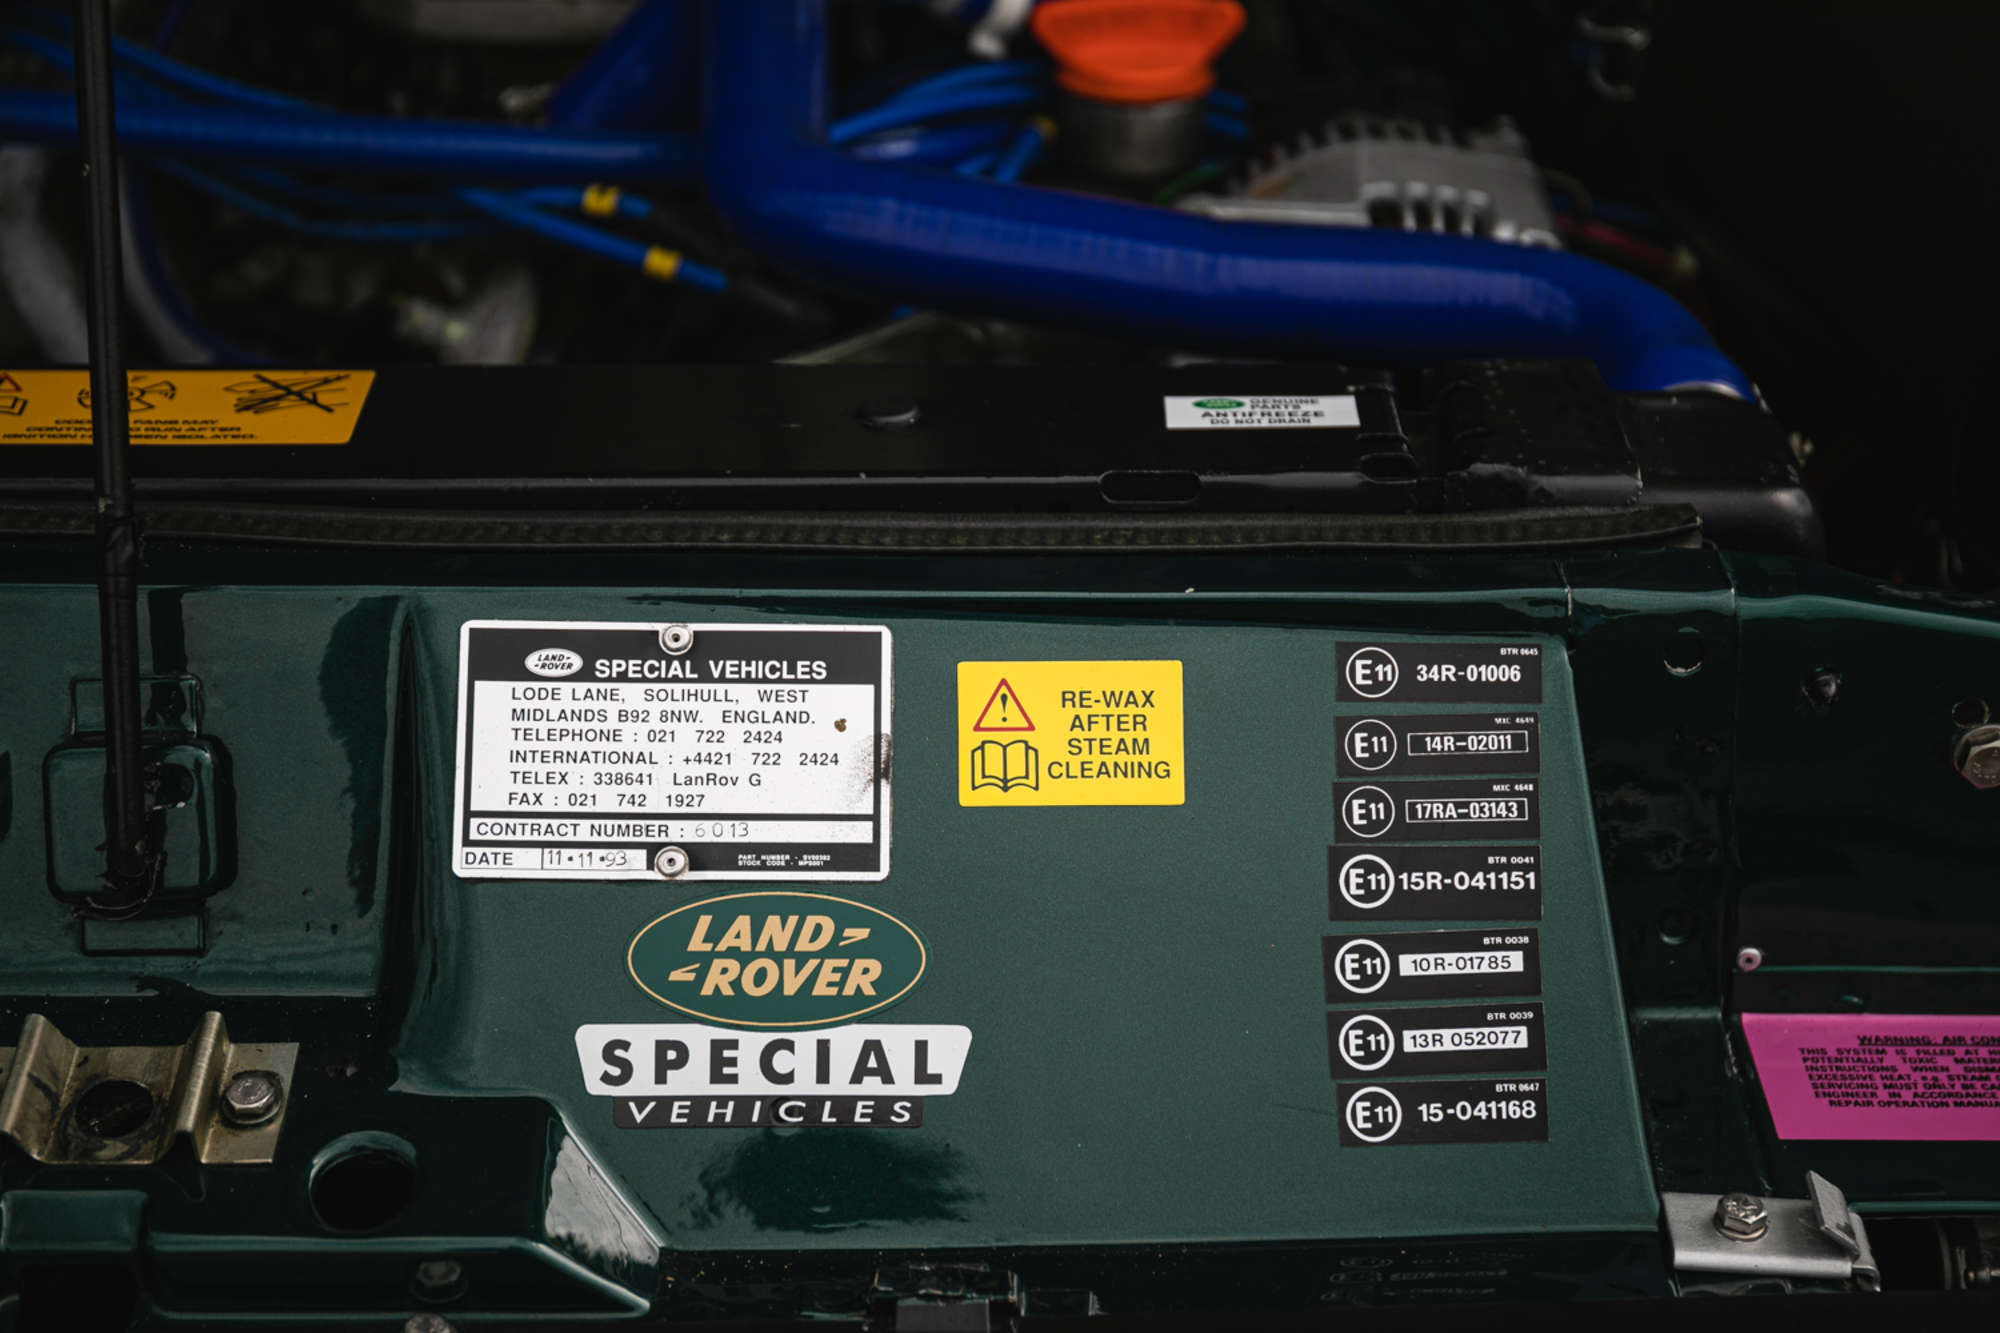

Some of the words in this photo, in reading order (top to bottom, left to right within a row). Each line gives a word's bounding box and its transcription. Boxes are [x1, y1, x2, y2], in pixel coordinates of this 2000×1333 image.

[1500, 648, 1519, 656] BTR
[540, 662, 574, 670] ROVER
[594, 659, 698, 679] SPECIAL
[709, 660, 828, 680] VEHICLES
[1416, 664, 1521, 682] 34R-01006
[511, 687, 561, 701] LODE
[572, 687, 625, 704] LANE,
[643, 688, 740, 704] SOLIHULL,
[757, 689, 809, 703] WEST
[1061, 690, 1155, 709] RE-WAX
[511, 708, 608, 722] MIDLANDS
[618, 709, 650, 723] B92
[659, 710, 703, 723] 8NW.
[721, 710, 815, 724] ENGLAND.
[1070, 714, 1147, 732] AFTER
[511, 728, 623, 742] TELEPHONE
[647, 729, 676, 743] 021
[695, 730, 725, 743] 722
[743, 730, 783, 744] 2424
[1425, 734, 1512, 752] 14R-02011
[1067, 738, 1150, 756] STEAM
[509, 750, 659, 765] INTERNATIONAL
[682, 752, 732, 765] +4421
[751, 752, 781, 766] 722
[799, 753, 840, 766] 2424
[1047, 761, 1171, 779] CLEANING
[510, 771, 569, 785] TELEX
[593, 772, 653, 786] 338641
[673, 773, 739, 786] LanRov
[748, 773, 762, 787] G
[1493, 784, 1510, 792] MXC
[508, 792, 543, 806] FAX
[568, 793, 597, 807] 021
[616, 794, 647, 807] 742
[666, 794, 705, 808] 1927
[1415, 802, 1518, 819] 17RA-03143
[476, 822, 580, 837] CONTRACT
[590, 823, 669, 838] NUMBER
[464, 852, 513, 866] DATE
[1399, 871, 1536, 890] 15R-041151
[686, 914, 836, 952] LAND
[1483, 937, 1503, 945] BTR
[1505, 936, 1529, 944] 0038
[700, 958, 883, 997] ROVER
[1487, 1013, 1506, 1021] BTR
[1509, 1012, 1534, 1020] 0039
[1410, 1034, 1444, 1048] 13R
[1451, 1030, 1522, 1047] 052077
[599, 1038, 943, 1087] SPECIAL
[1802, 1056, 1884, 1064] POTENTIALLY
[1496, 1084, 1516, 1092] BTR
[1811, 1082, 1879, 1090] SERVICING
[1883, 1082, 1918, 1090] MUST
[1418, 1100, 1537, 1122] 15-041168
[1878, 1100, 1950, 1108] OPERATION
[628, 1101, 912, 1124] VEHICLES
